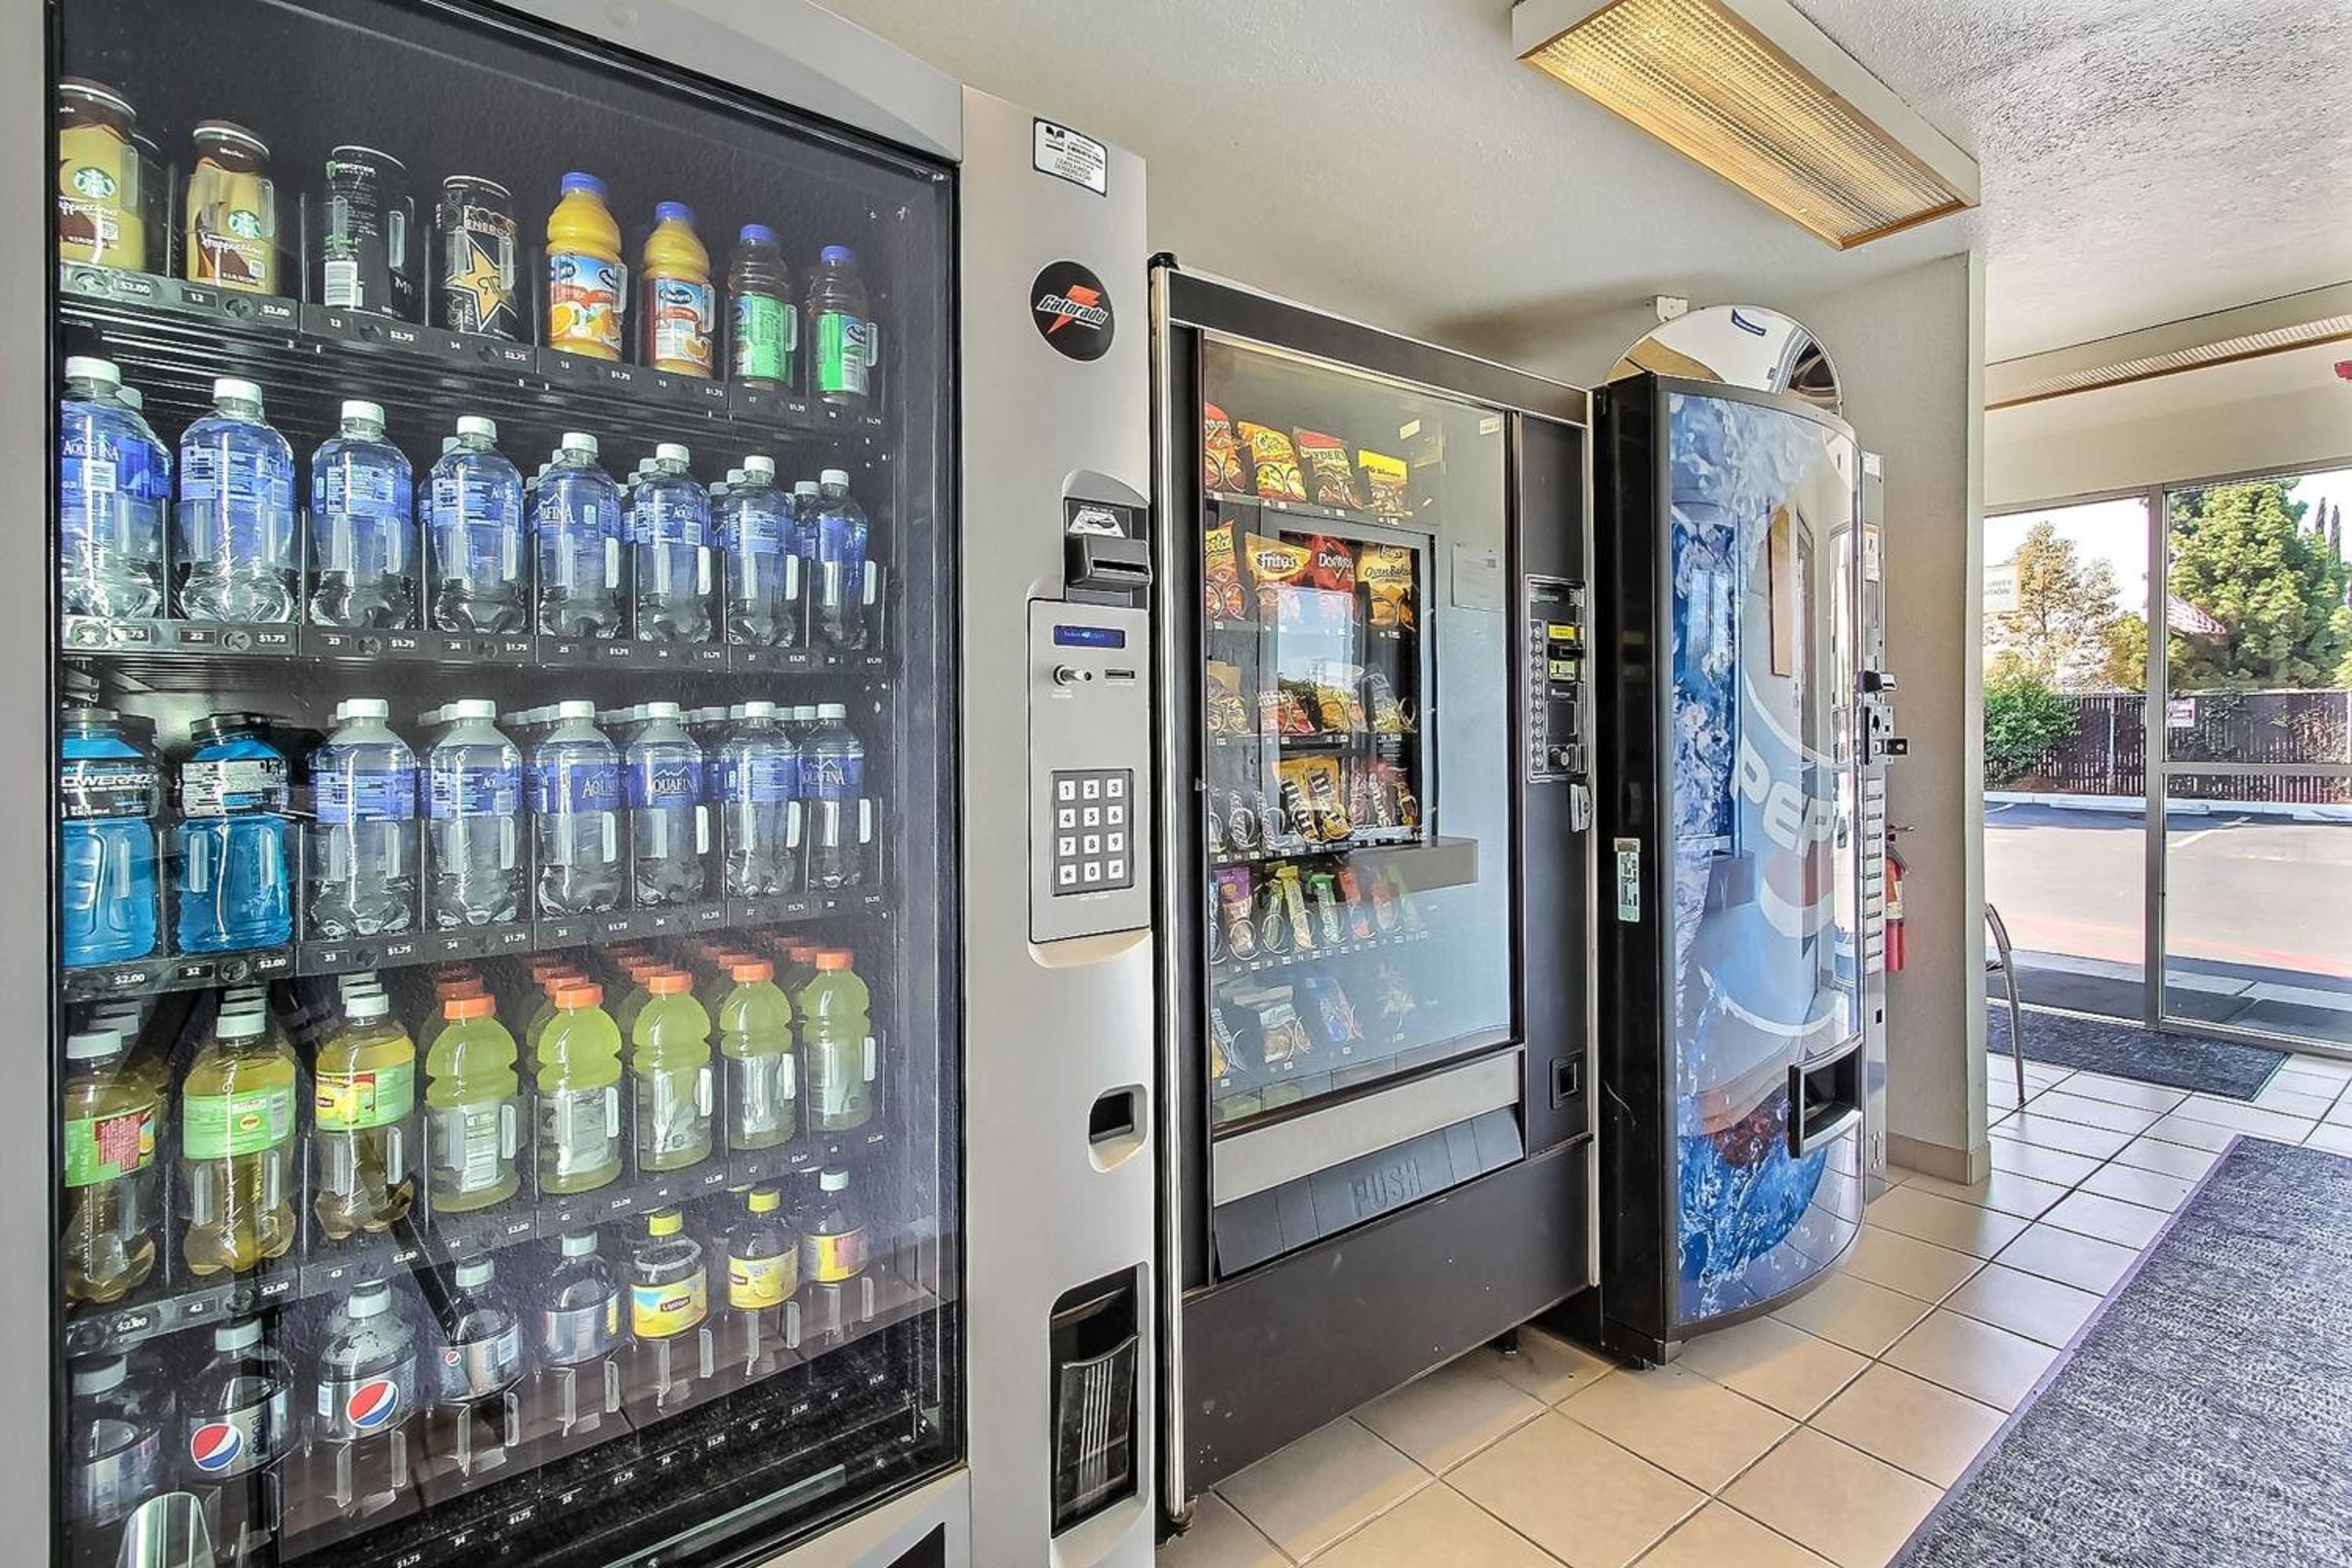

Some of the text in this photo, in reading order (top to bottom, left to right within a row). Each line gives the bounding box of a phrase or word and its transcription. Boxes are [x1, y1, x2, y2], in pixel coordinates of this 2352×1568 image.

[120, 280, 150, 293] $2.00
[191, 292, 204, 303] 12
[263, 304, 290, 317] $2.00
[1039, 293, 1109, 323] Gatorade
[1258, 550, 1295, 568] Fritos
[1318, 552, 1355, 568] Doritos
[259, 633, 286, 643] $1.75
[391, 639, 415, 648] $1.75
[506, 642, 528, 652] $1.75
[505, 932, 526, 943] $1.75
[387, 945, 412, 956] $1.75
[259, 958, 286, 969] $2.00
[187, 967, 200, 976] 32
[114, 973, 145, 985] $2.00
[1348, 1156, 1425, 1218] PUSH
[508, 1222, 529, 1235] $2.00
[393, 1250, 418, 1264] $2.00
[262, 1281, 289, 1296] $2.00
[189, 1303, 203, 1312] 42
[662, 1295, 690, 1312] Lipton
